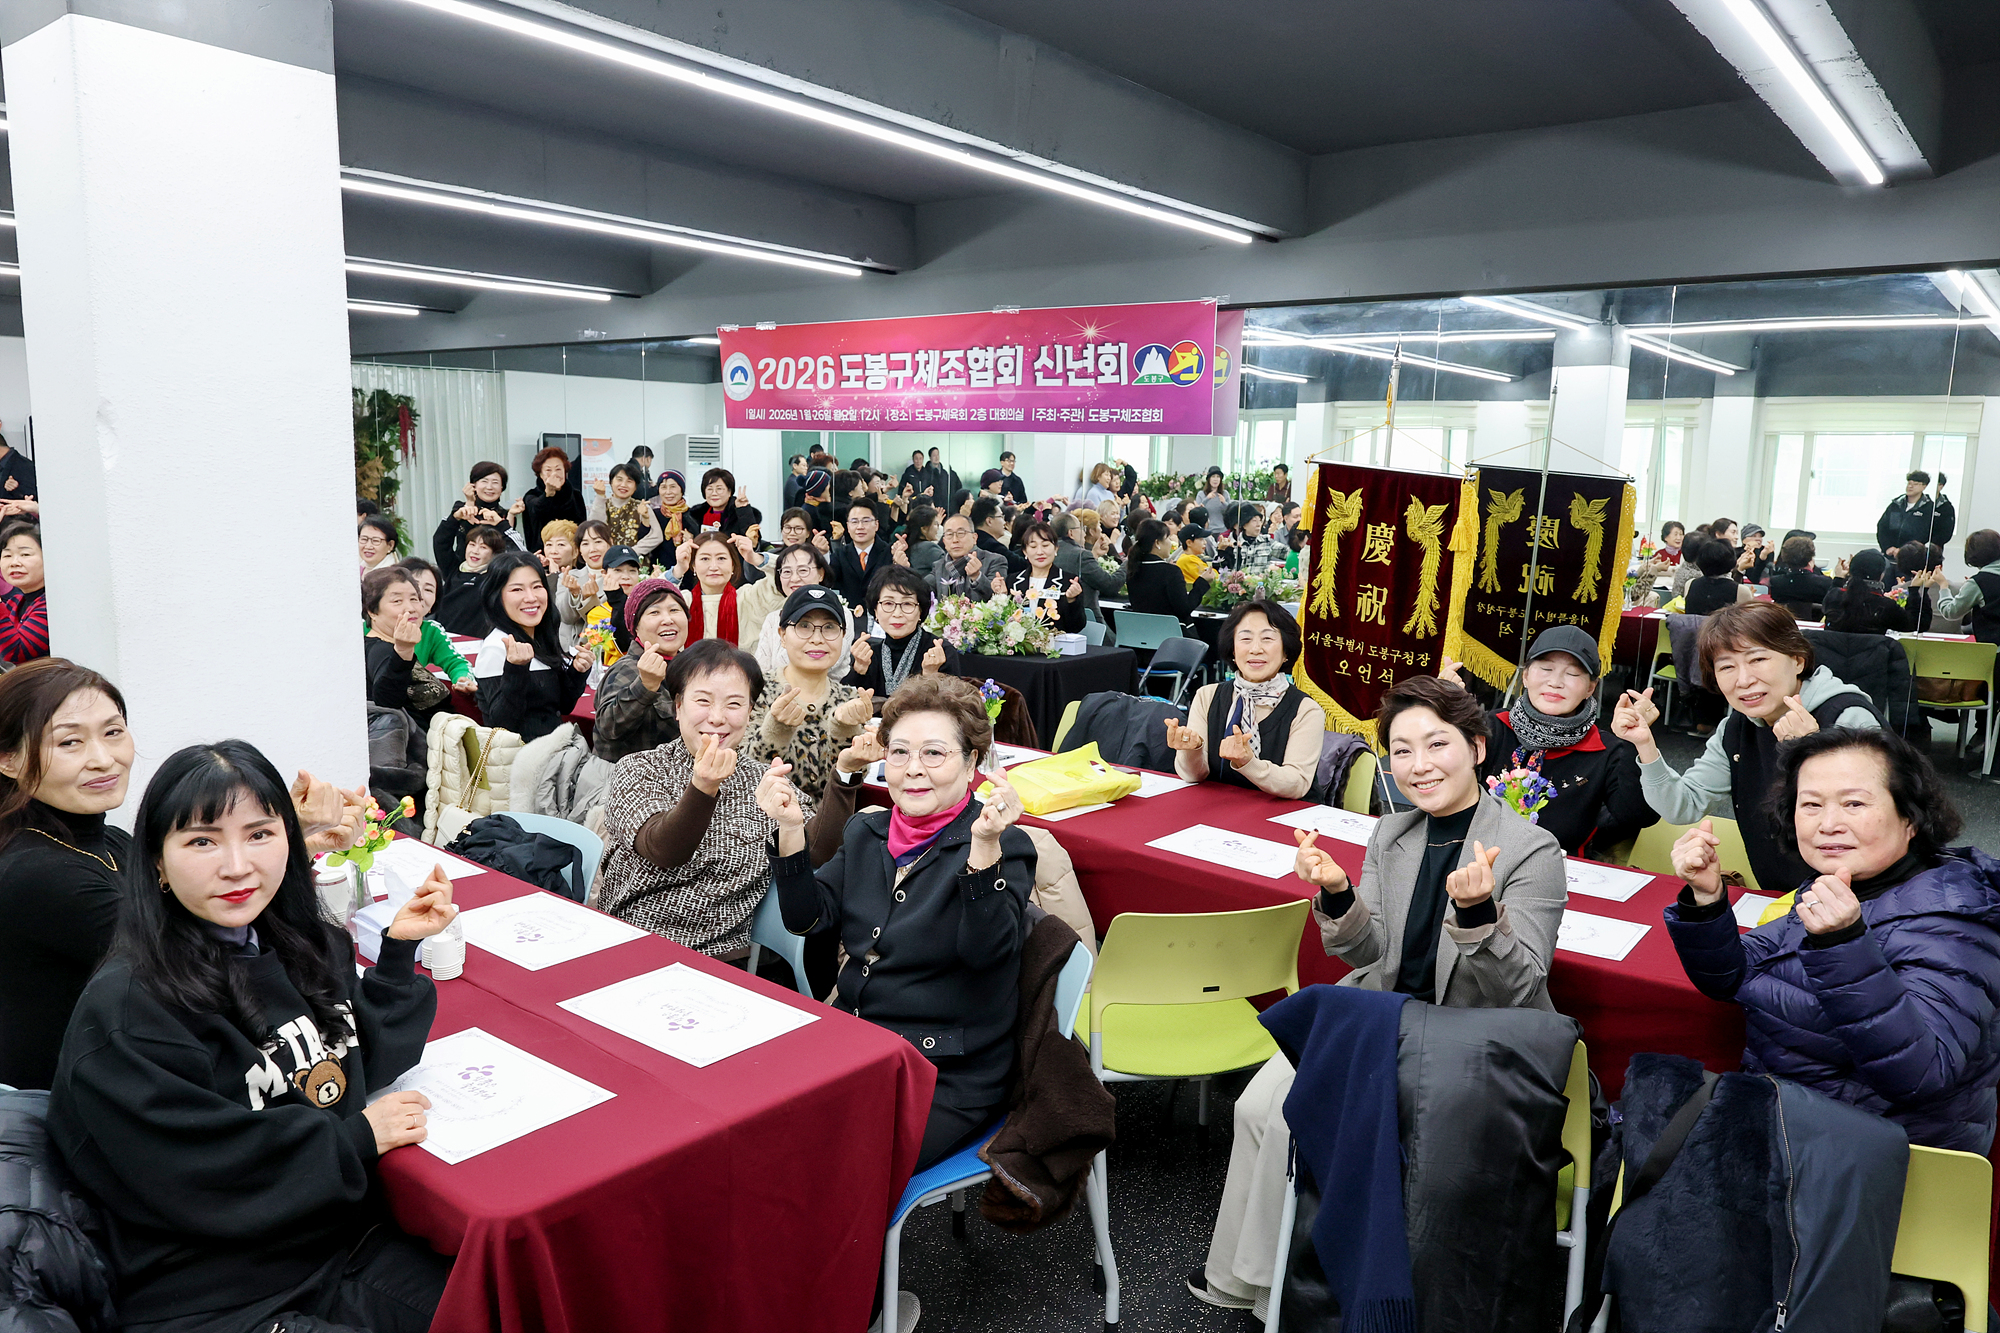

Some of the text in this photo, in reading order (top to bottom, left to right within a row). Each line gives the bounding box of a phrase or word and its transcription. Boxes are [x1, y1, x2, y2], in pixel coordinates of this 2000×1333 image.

[757, 355, 835, 390] 2026
[839, 345, 1024, 391] 도봉구체조협회
[1033, 342, 1129, 387] 신년회
[1143, 375, 1164, 384] 도봉구
[768, 408, 798, 421] 2026년
[812, 409, 832, 422] 26일
[832, 408, 857, 422] 월요일
[860, 408, 880, 422] 12시
[915, 408, 968, 422] 도봉구체육회
[970, 408, 987, 421] 2층
[989, 408, 1025, 421] 대회의실
[1088, 408, 1164, 422] 도봉구체조협회
[1308, 631, 1431, 667] 서울특별시 도봉구청장
